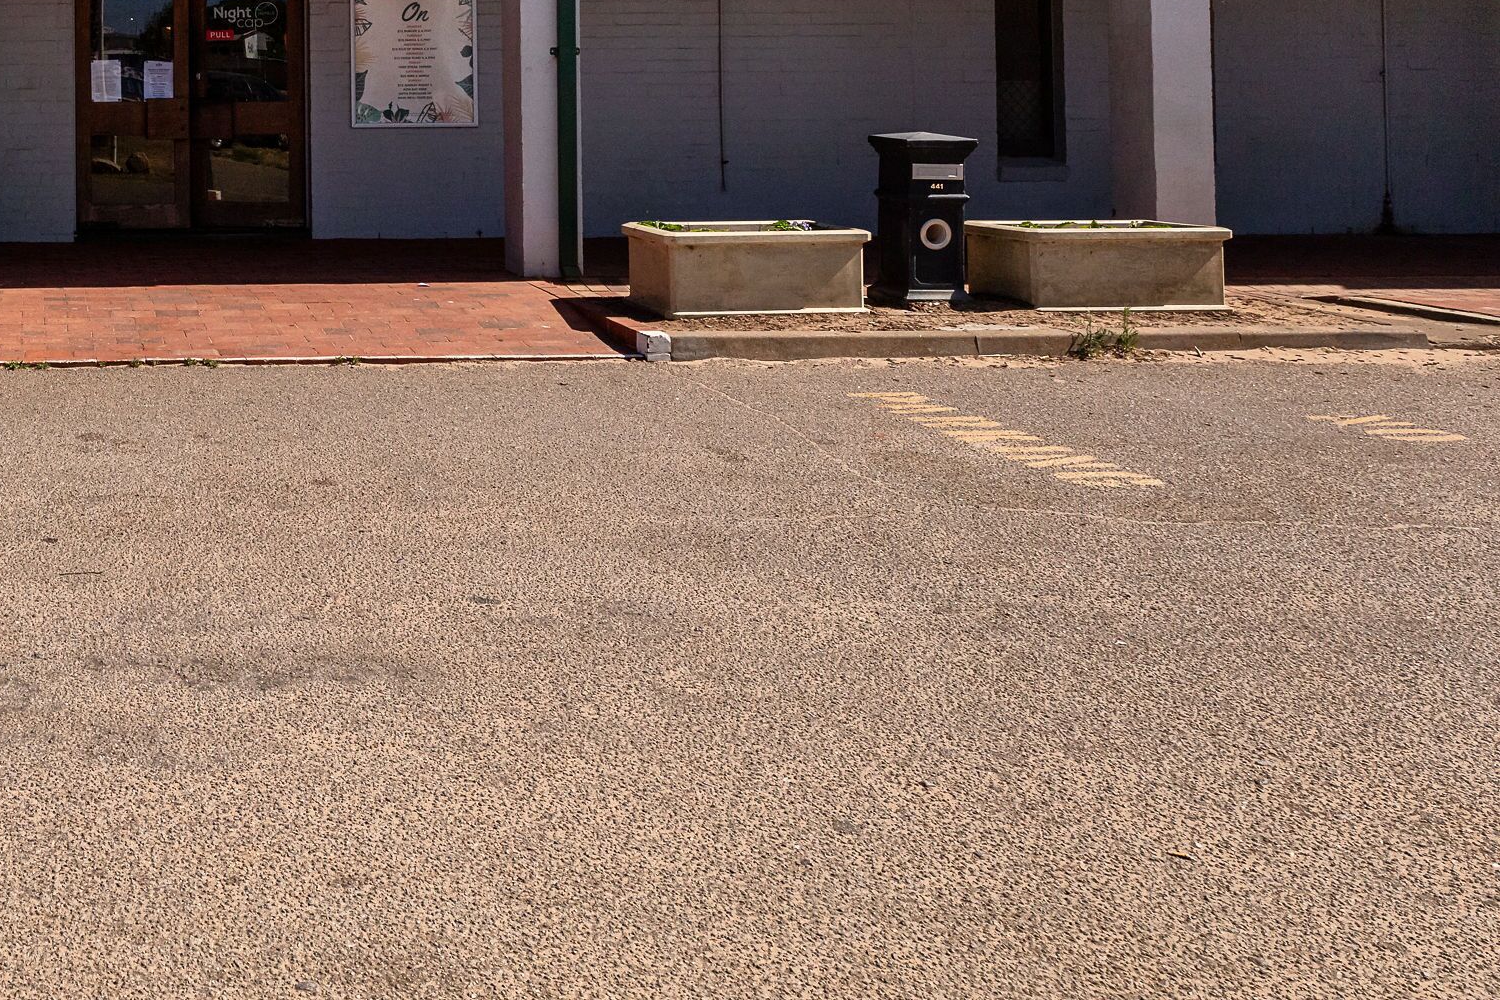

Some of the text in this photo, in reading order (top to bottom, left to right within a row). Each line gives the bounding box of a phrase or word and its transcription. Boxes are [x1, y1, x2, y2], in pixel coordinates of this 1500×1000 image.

[213, 6, 252, 23] Night
[401, 2, 429, 22] On
[237, 18, 264, 31] cap
[210, 31, 231, 39] PULL
